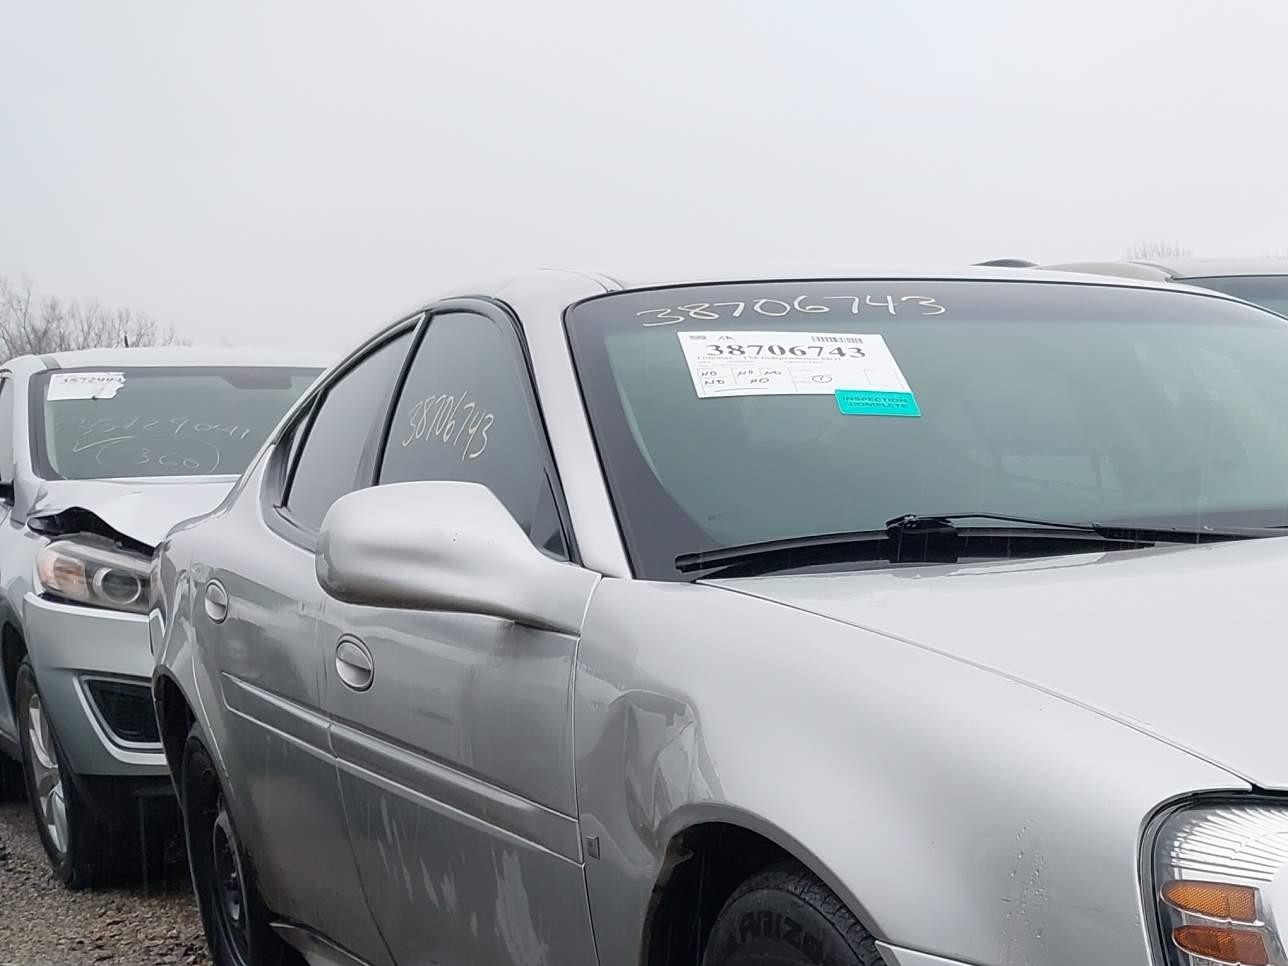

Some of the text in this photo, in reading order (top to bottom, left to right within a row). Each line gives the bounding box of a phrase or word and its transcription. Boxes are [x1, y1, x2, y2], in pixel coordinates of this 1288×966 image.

[636, 294, 947, 326] 38706743
[705, 343, 867, 359] 38706743
[842, 396, 909, 404] INSPECTION
[402, 391, 495, 462] 38706743
